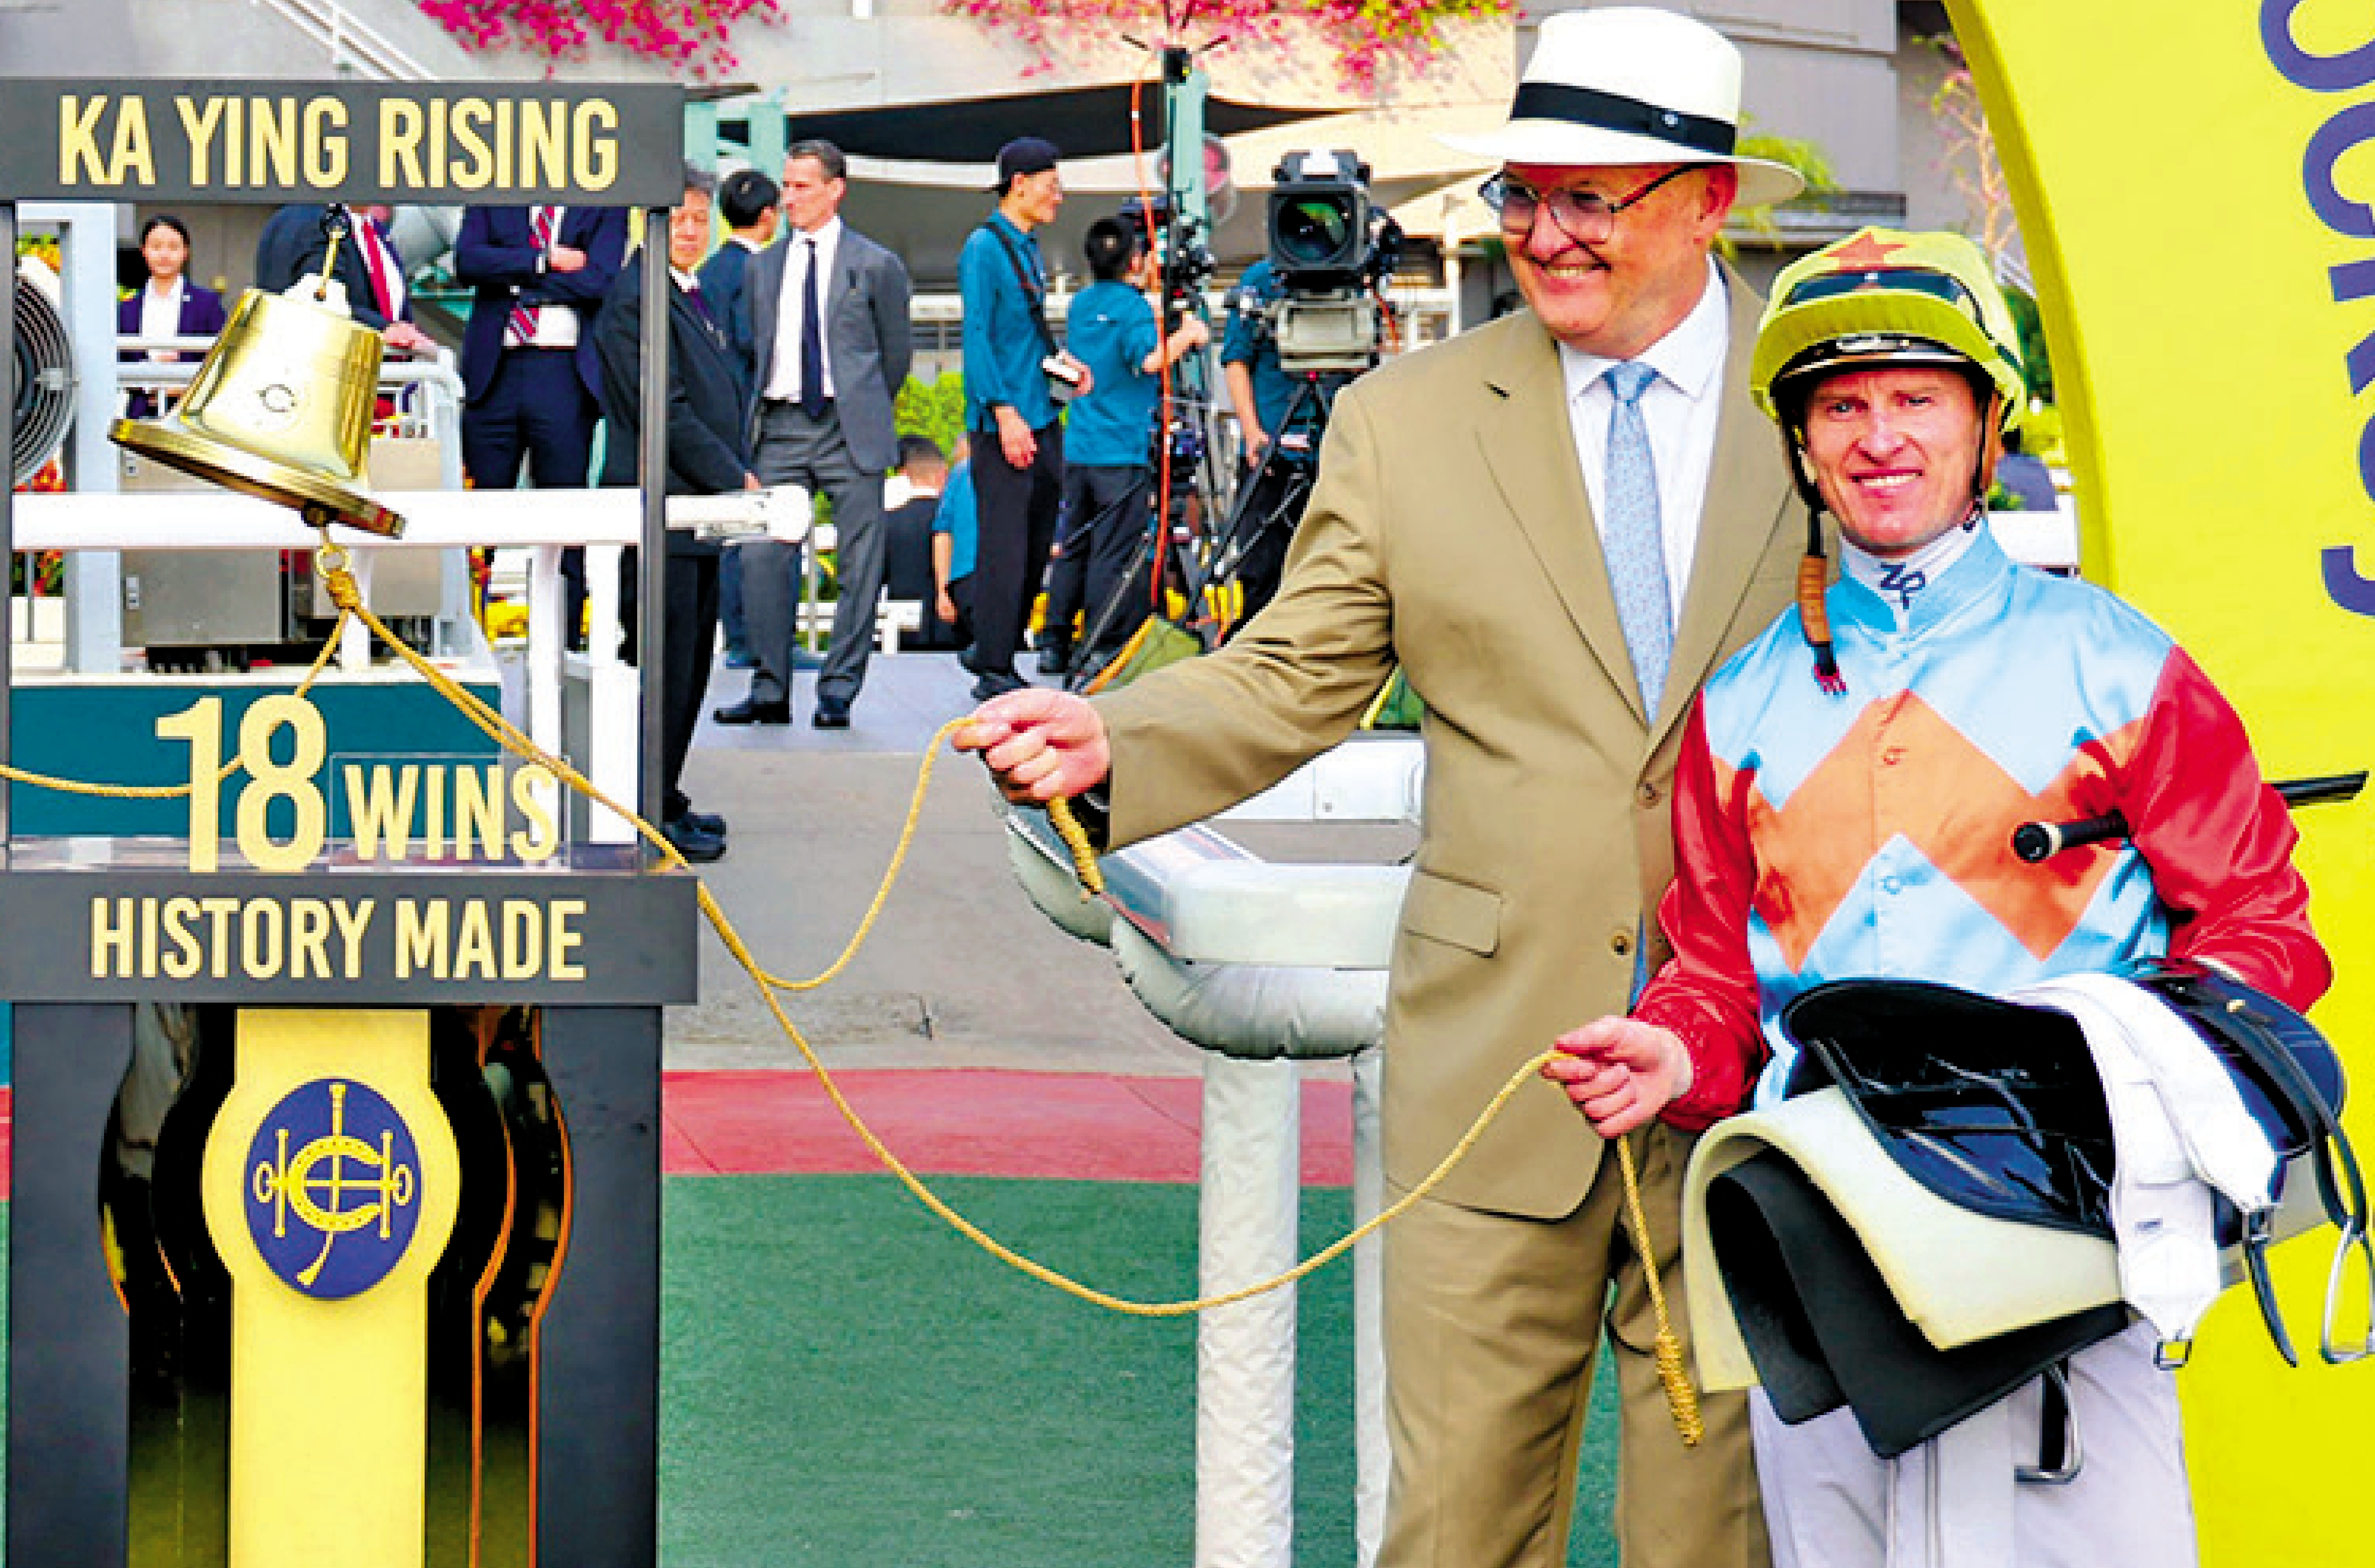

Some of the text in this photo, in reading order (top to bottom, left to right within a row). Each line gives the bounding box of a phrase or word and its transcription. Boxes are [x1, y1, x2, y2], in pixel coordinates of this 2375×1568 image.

[60, 94, 618, 191] KA YING RISING
[154, 694, 557, 872] 18 WINS
[90, 897, 587, 980] HISTORY MADE
